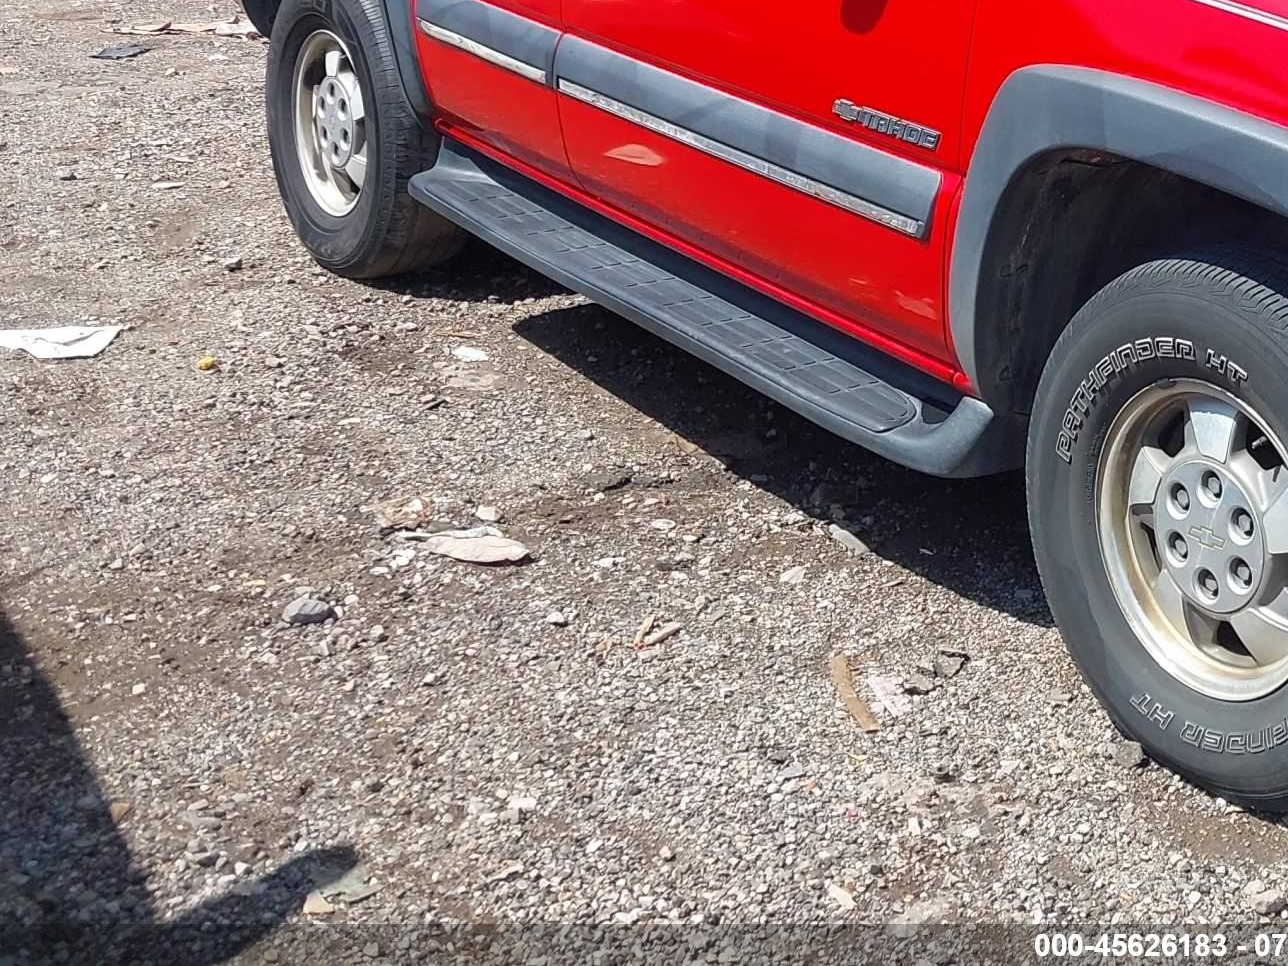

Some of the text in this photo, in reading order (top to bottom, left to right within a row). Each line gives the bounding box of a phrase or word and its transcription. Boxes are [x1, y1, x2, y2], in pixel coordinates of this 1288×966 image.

[858, 106, 941, 151] TAHOE
[1056, 337, 1197, 464] PATHFINDER
[1206, 348, 1248, 386] HT
[1129, 693, 1175, 731] HT
